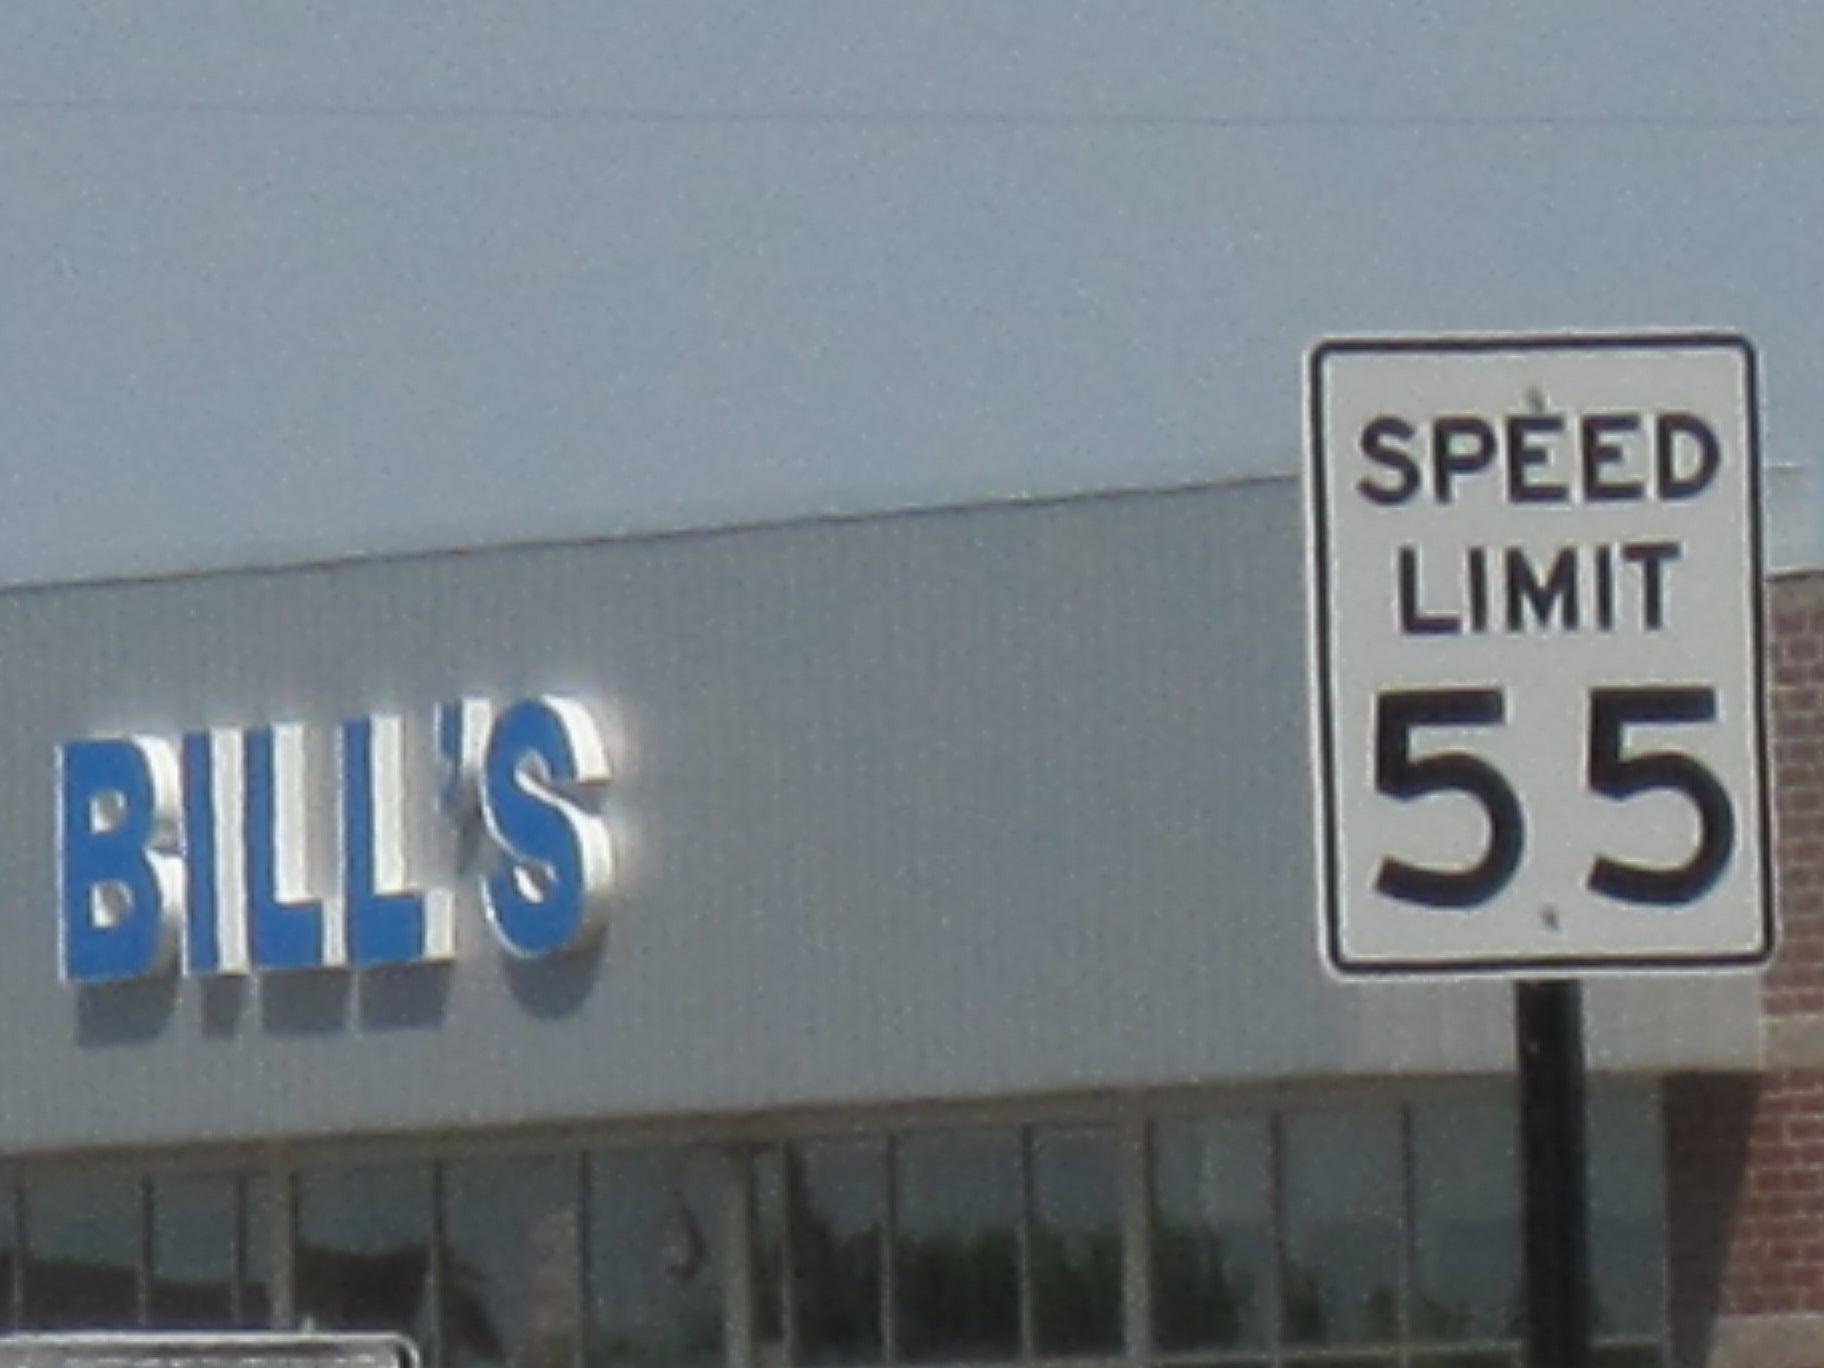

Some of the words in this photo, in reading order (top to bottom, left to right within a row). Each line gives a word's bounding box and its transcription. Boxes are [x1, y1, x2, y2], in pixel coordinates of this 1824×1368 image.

[1357, 413, 1721, 505] SPEED
[1398, 541, 1681, 634] LIMIT
[56, 694, 612, 982] BILL'S
[1374, 686, 1734, 908] 55
